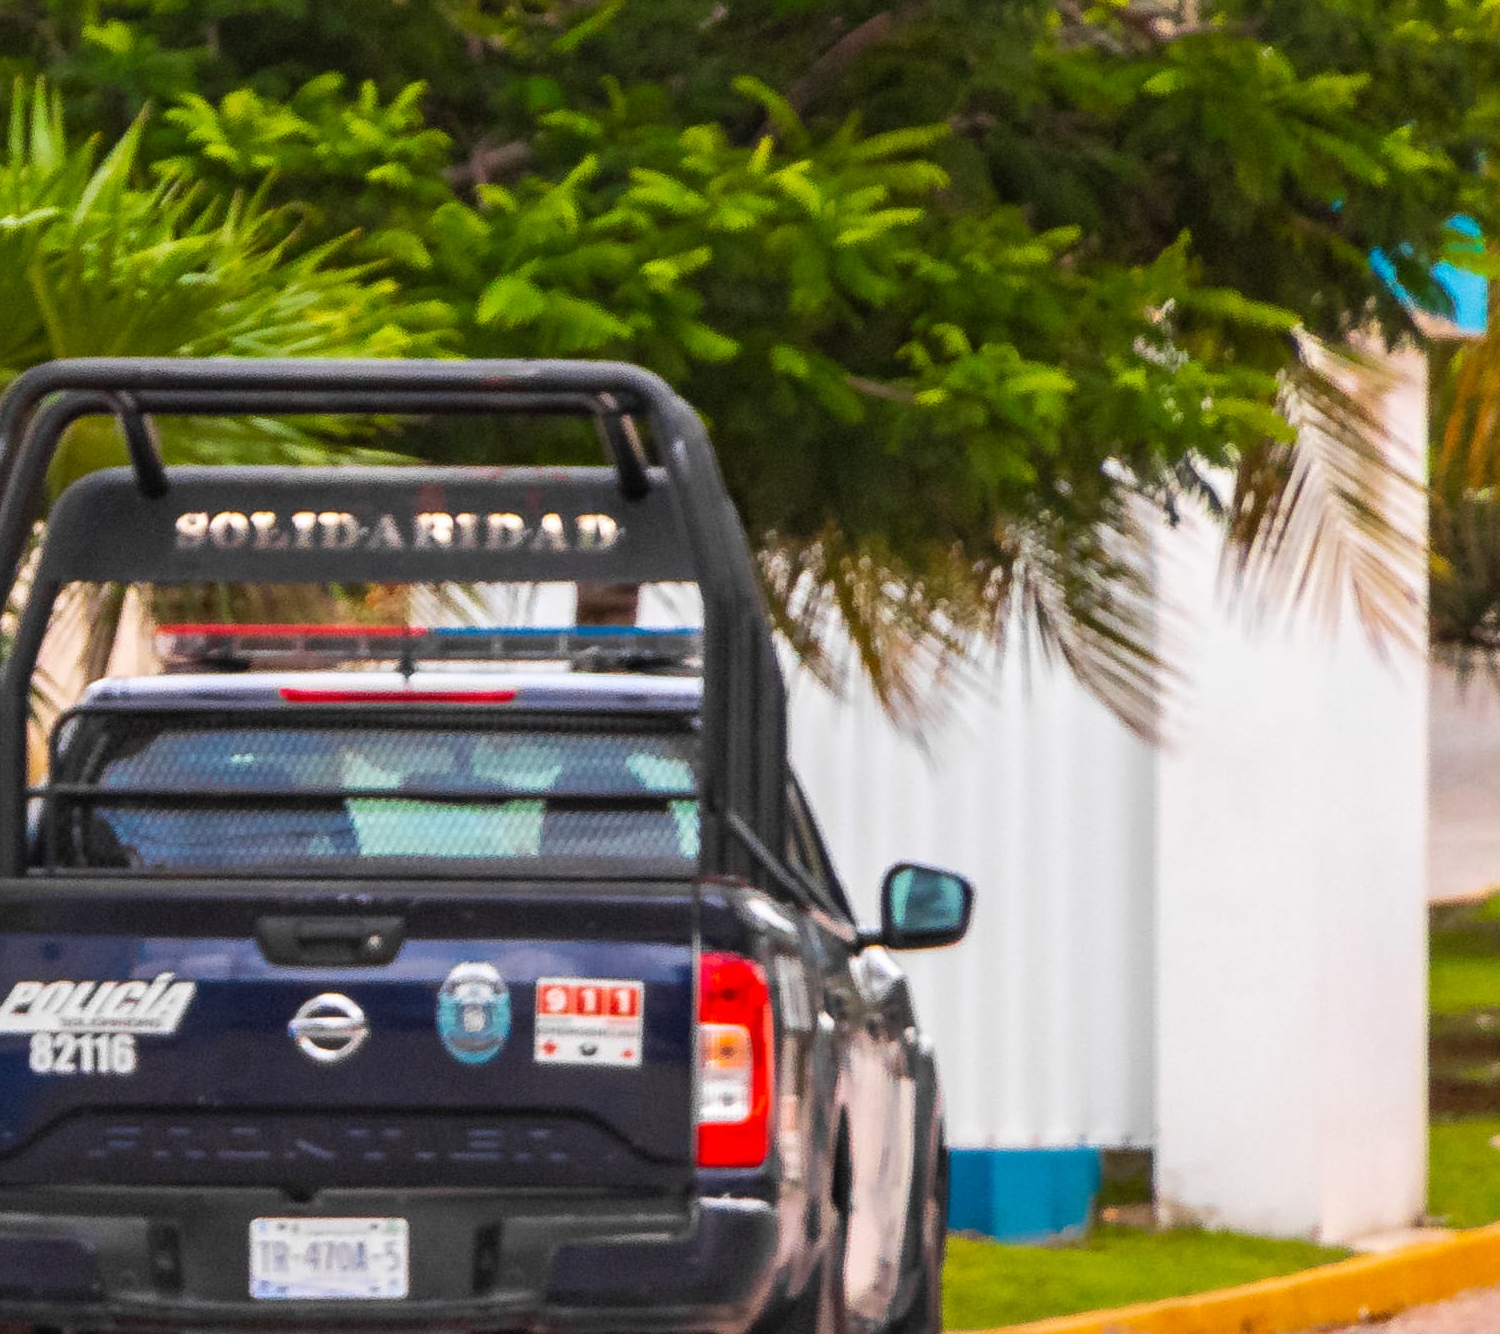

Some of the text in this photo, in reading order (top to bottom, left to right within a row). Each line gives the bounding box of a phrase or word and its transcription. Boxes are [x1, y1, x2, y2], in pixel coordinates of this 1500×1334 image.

[0, 971, 195, 1017] POLICÍA
[544, 986, 631, 1015] 911
[29, 1032, 137, 1074] 82116
